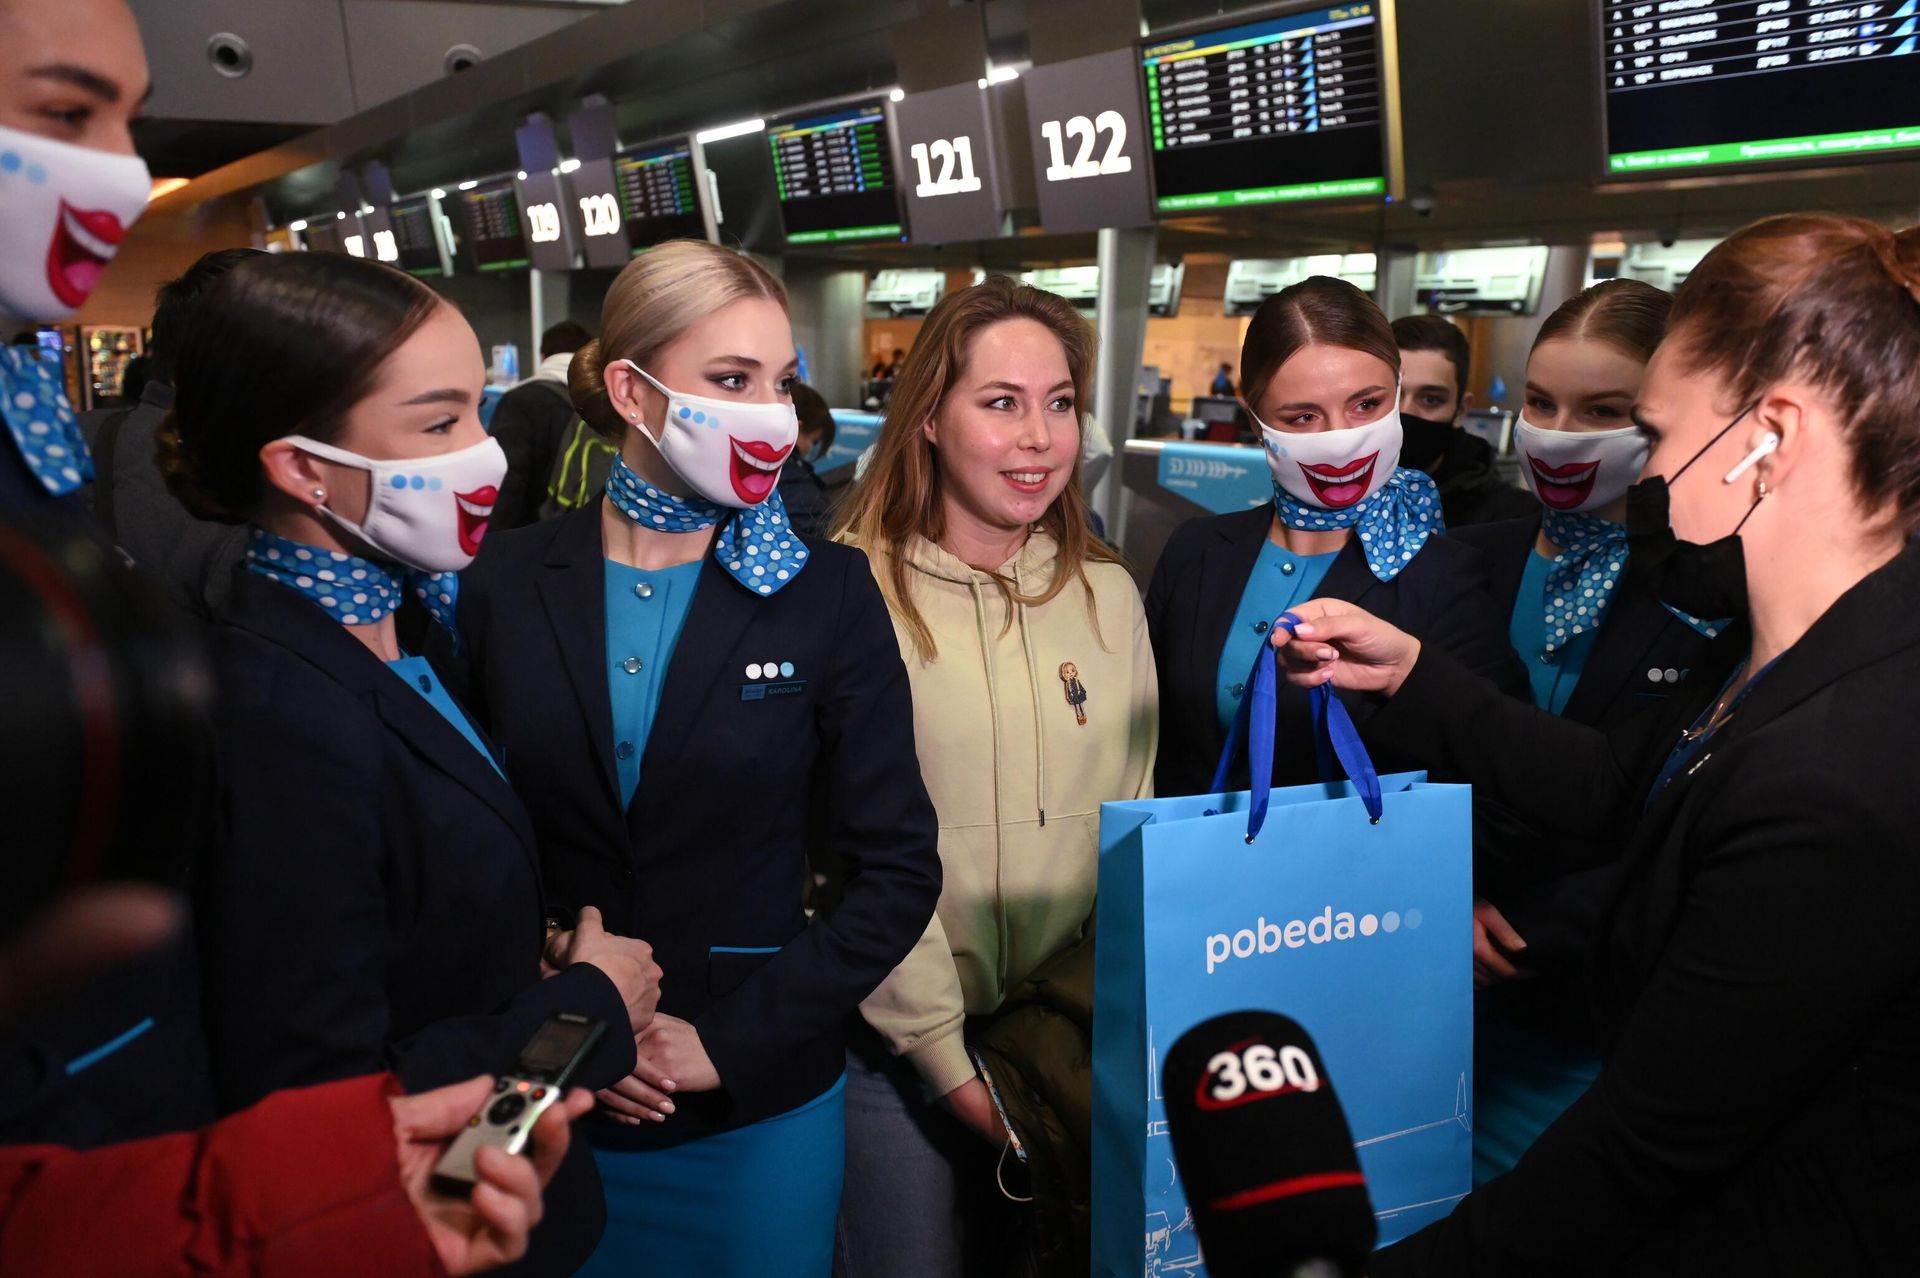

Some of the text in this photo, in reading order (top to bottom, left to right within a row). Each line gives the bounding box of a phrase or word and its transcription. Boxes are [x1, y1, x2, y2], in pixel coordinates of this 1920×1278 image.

[910, 135, 982, 198] 121
[1041, 110, 1132, 182] 122
[526, 202, 561, 243] 119
[579, 192, 621, 237] 120
[1206, 905, 1355, 975] pobeda
[1207, 1043, 1320, 1101] 360
